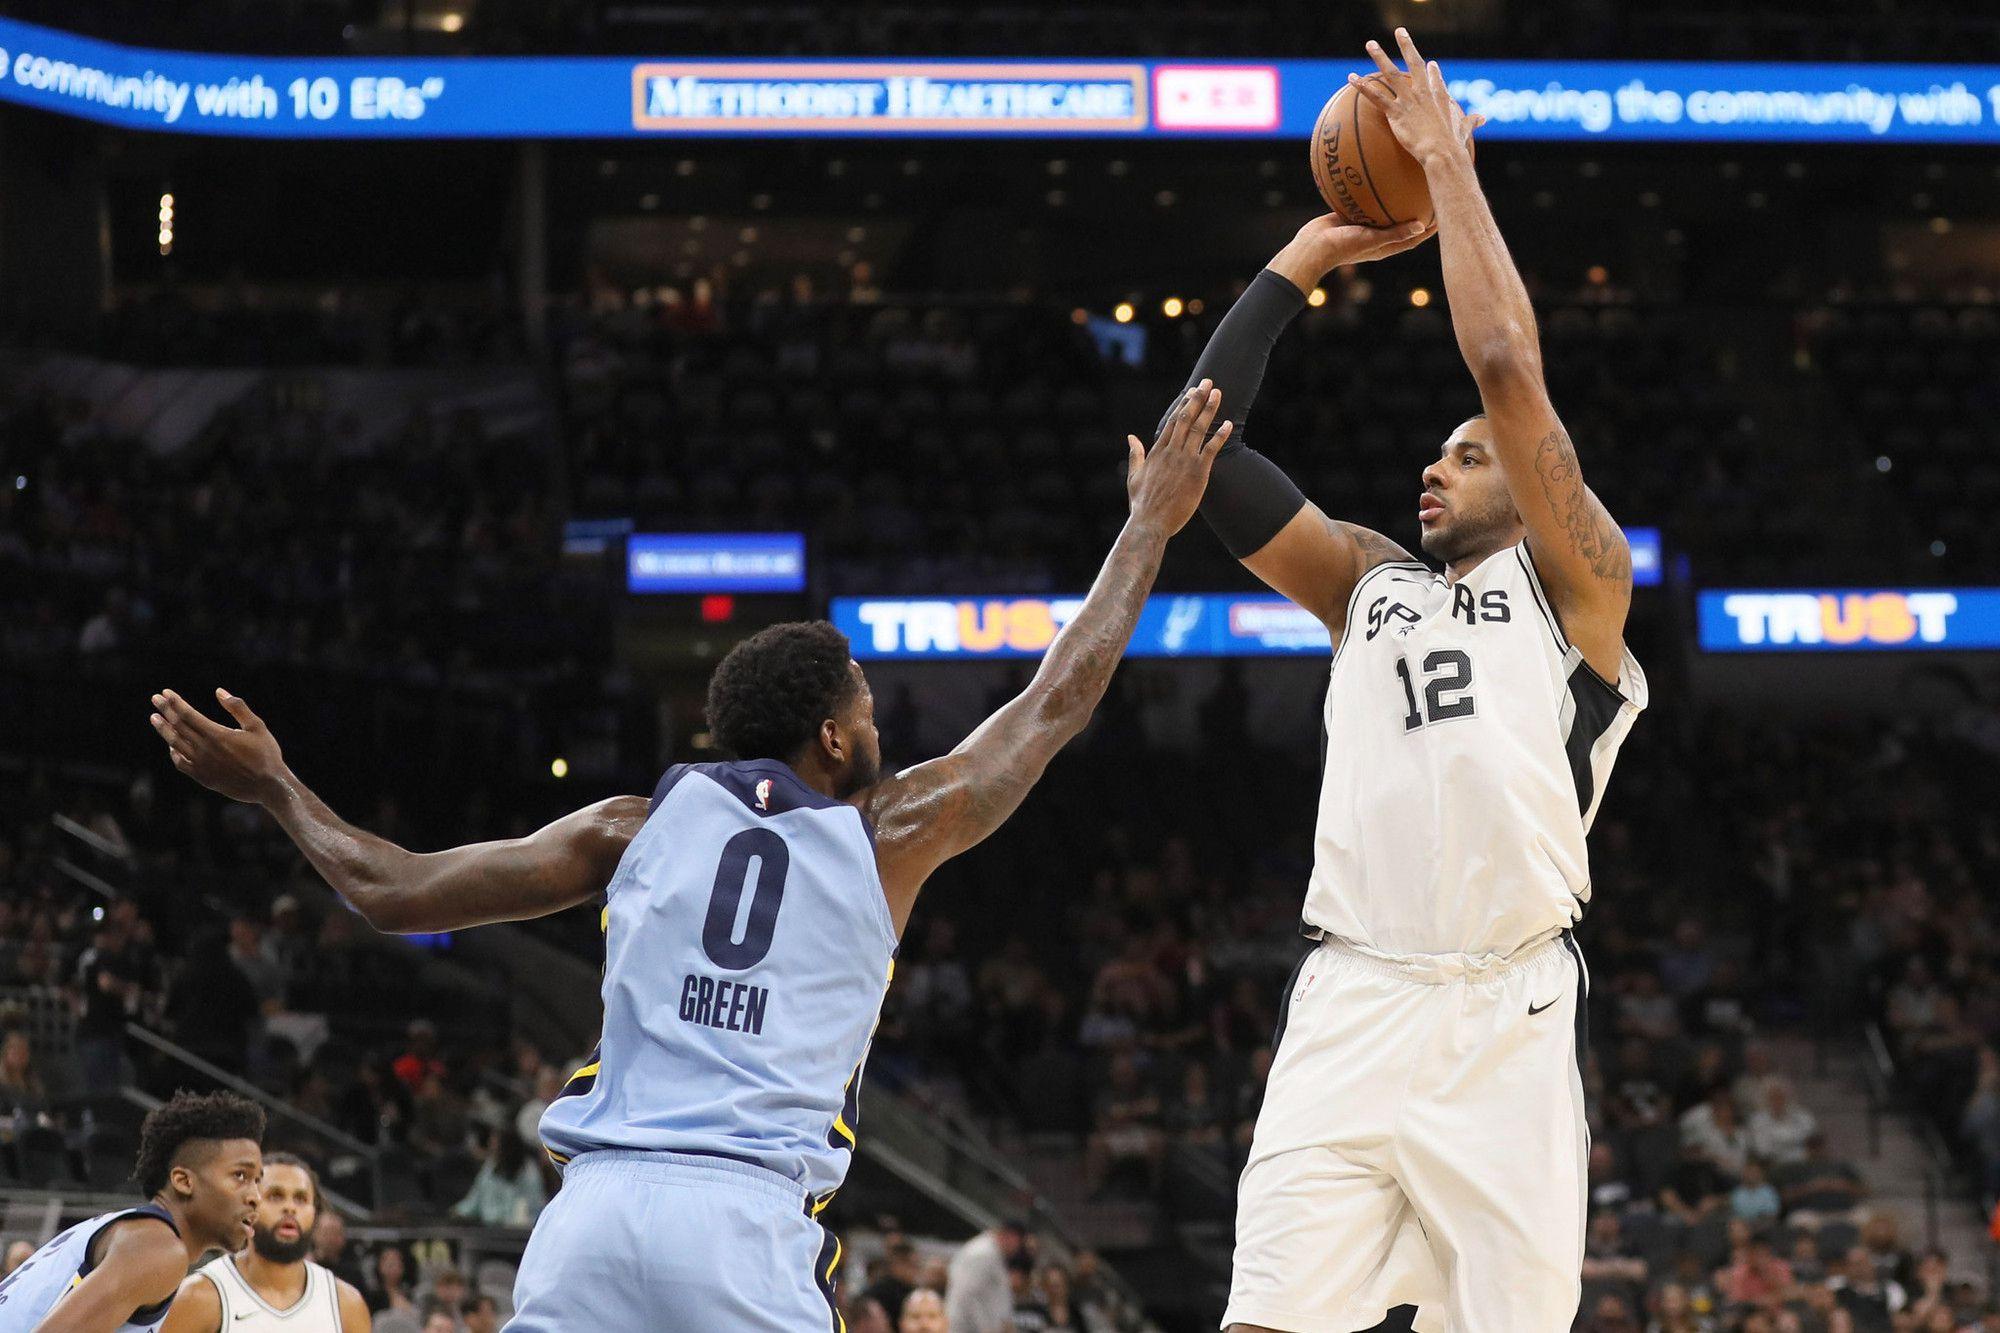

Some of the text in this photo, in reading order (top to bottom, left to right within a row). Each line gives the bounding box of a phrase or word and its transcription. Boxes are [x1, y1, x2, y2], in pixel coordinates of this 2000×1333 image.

[14, 53, 190, 123] community
[194, 74, 278, 120] with
[288, 76, 340, 121] 10
[1615, 78, 1683, 124] the
[1686, 84, 1897, 134] community
[1899, 82, 1982, 126] with
[1366, 582, 1511, 642] SPRS
[1723, 592, 1957, 644] TRUST
[1396, 649, 1477, 733] 12
[702, 827, 789, 970] 0
[679, 974, 769, 1035] GREEN
